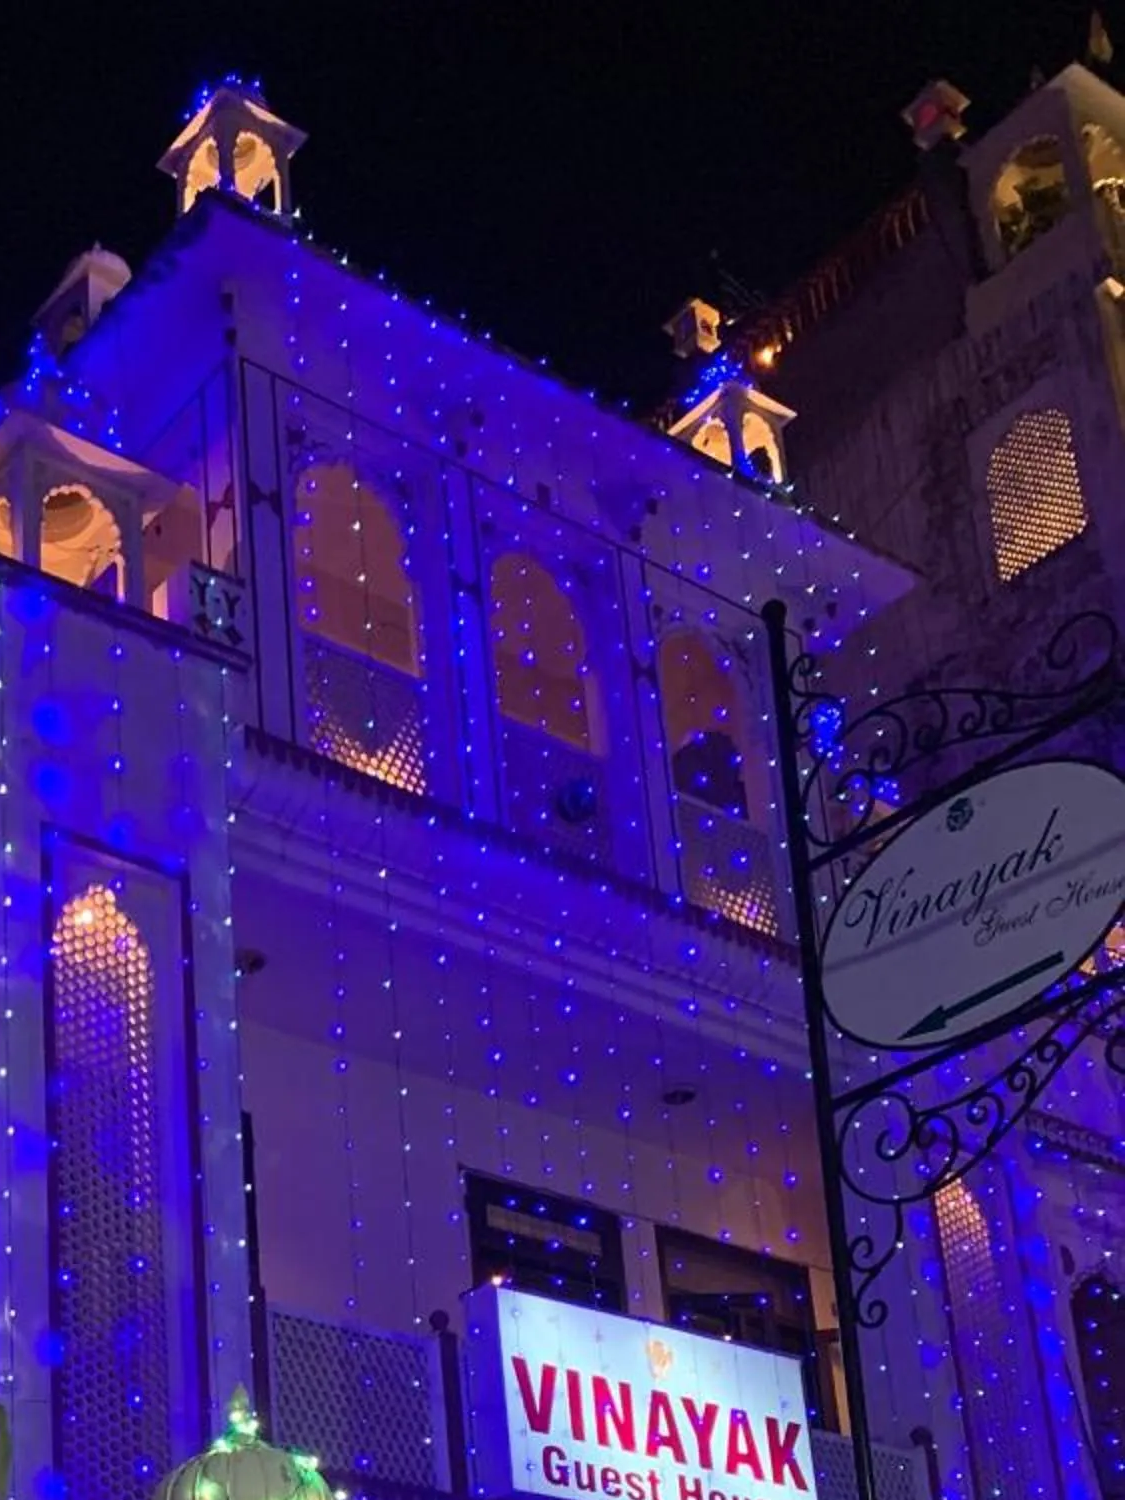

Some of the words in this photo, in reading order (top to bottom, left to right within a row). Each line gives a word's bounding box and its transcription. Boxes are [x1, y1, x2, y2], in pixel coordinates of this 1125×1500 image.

[843, 806, 1064, 949] Vinayak
[973, 902, 1040, 947] Guest
[511, 1355, 809, 1492] VINAYAK
